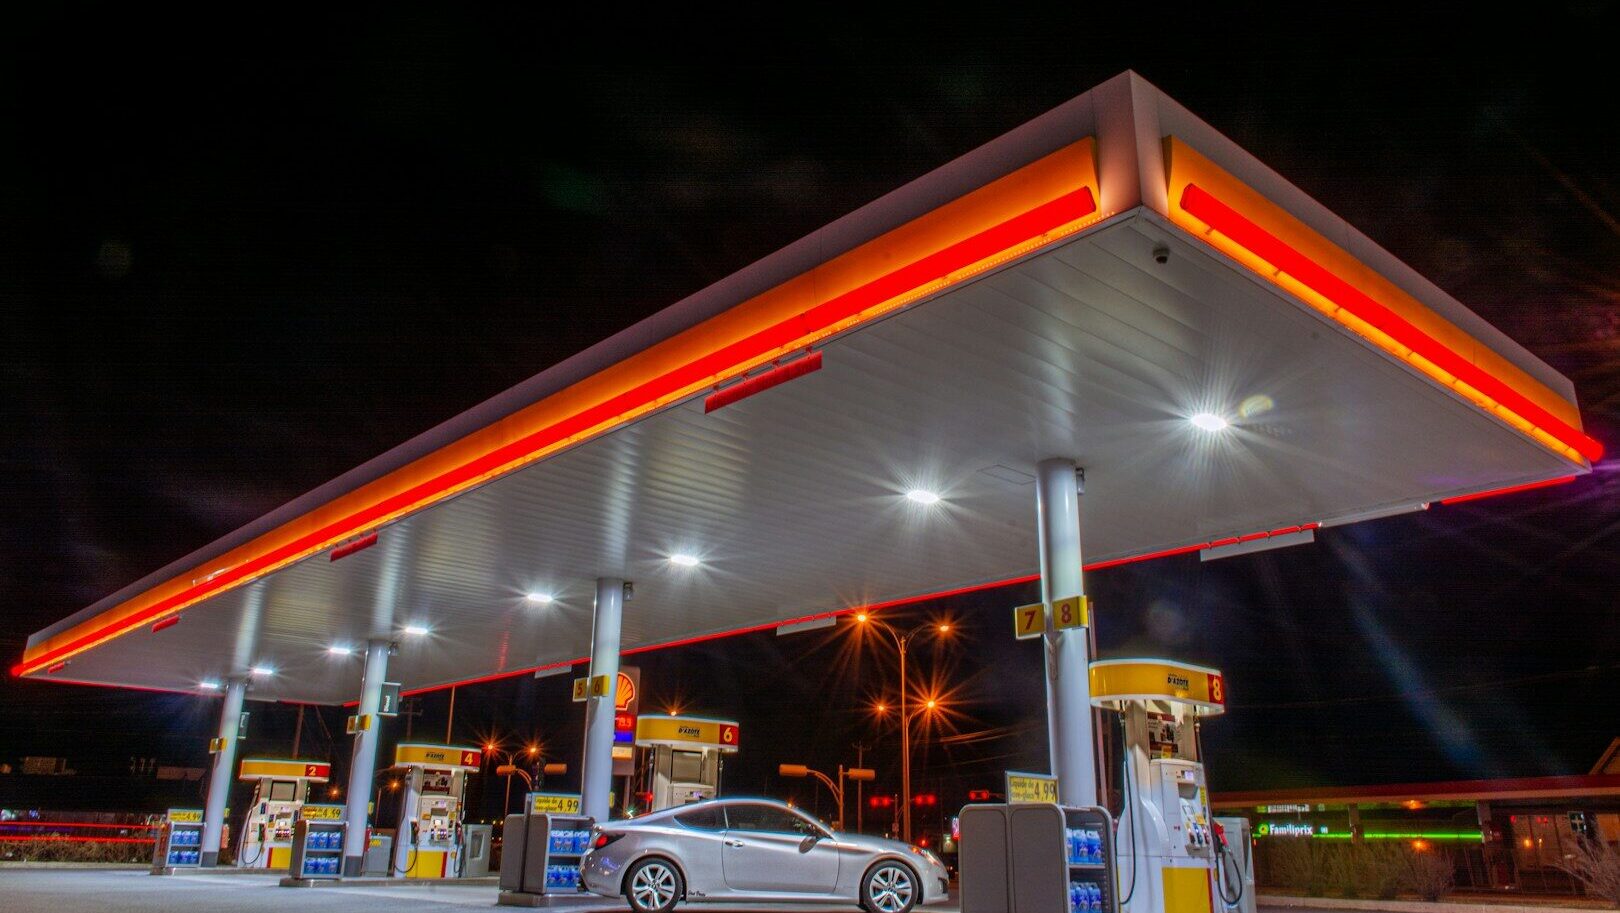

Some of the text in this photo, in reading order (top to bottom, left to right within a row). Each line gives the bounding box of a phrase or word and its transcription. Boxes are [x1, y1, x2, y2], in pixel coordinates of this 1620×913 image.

[1025, 610, 1037, 631] 7
[1061, 603, 1073, 625] 8
[577, 683, 584, 697] 5
[594, 680, 601, 692] 6
[1212, 677, 1222, 701] 8
[723, 727, 733, 743] 6
[464, 752, 474, 765] 4
[309, 765, 317, 776] 2
[1034, 782, 1056, 801] 4.99
[558, 799, 579, 812] 4.99
[1269, 824, 1314, 837] Familiprix
